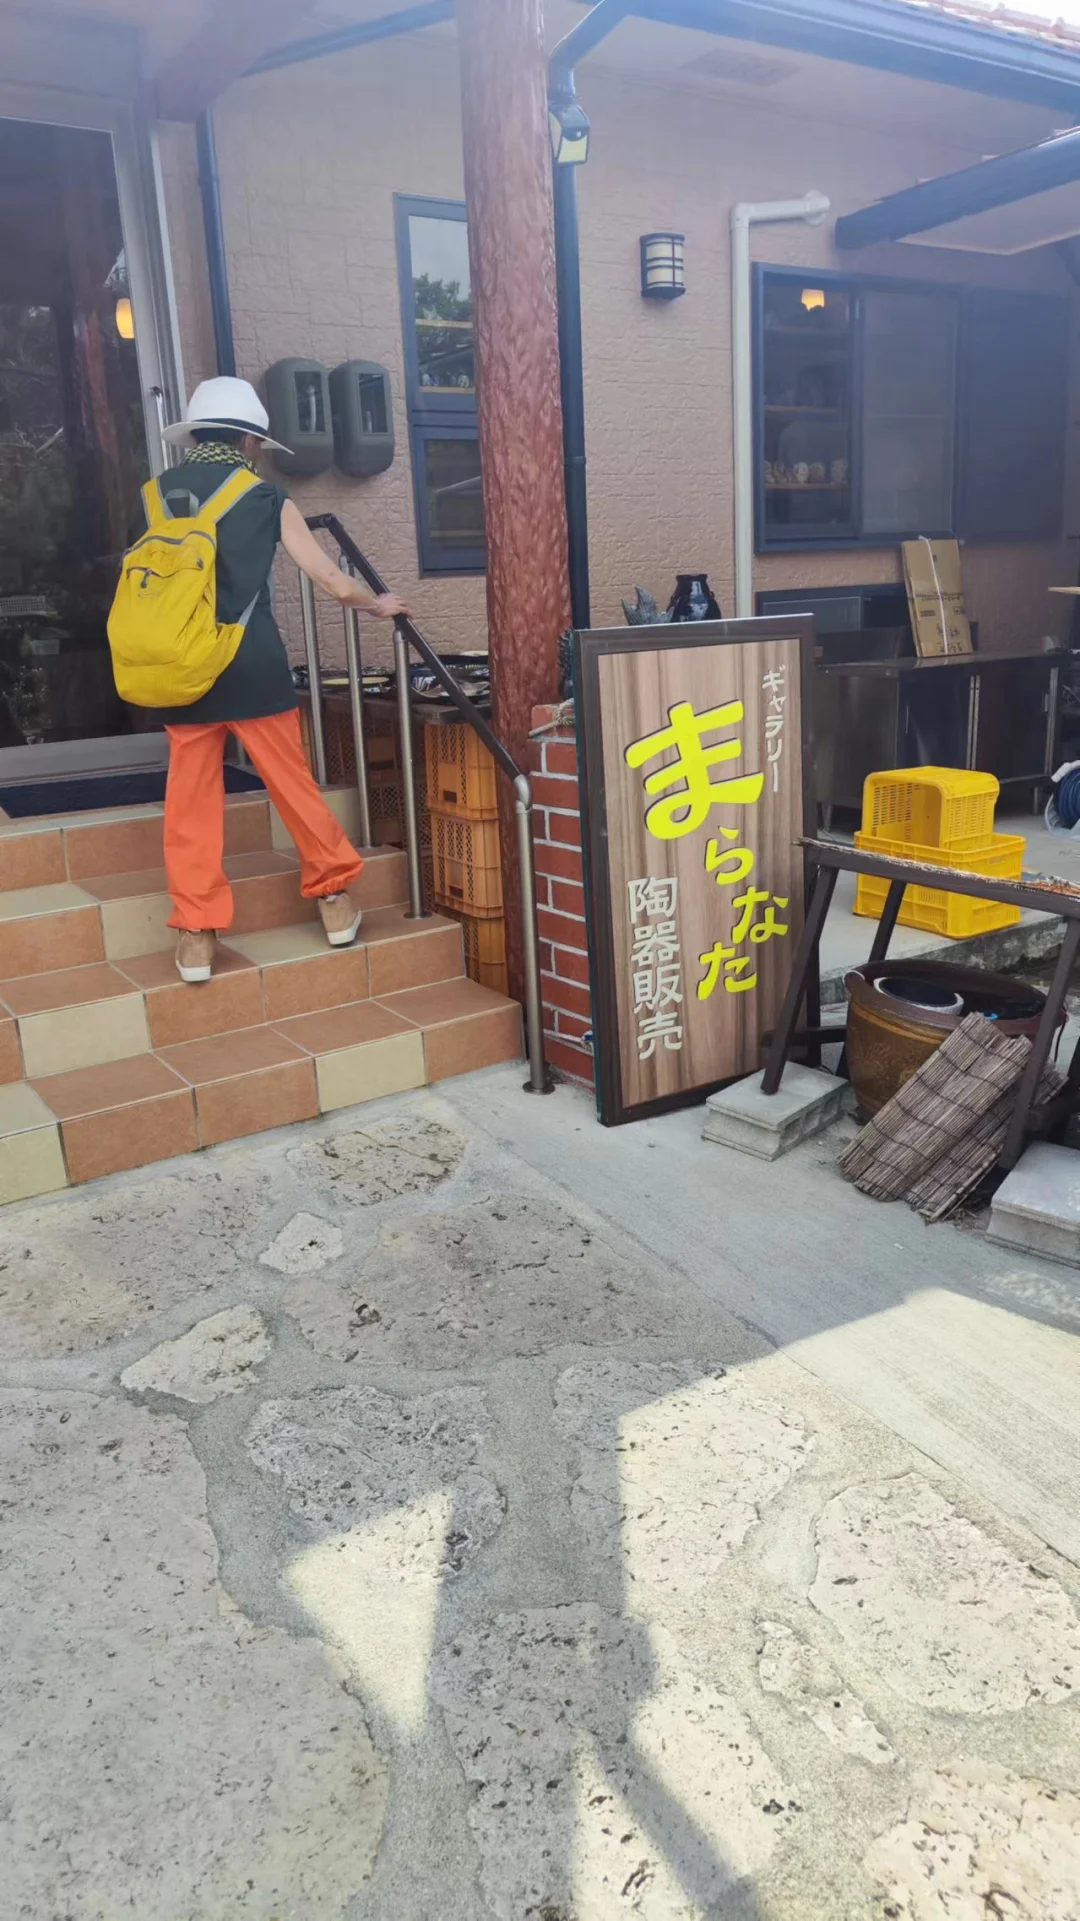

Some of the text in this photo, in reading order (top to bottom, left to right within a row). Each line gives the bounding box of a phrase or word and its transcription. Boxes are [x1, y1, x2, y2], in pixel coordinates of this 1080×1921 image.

[762, 665, 787, 792] ギャラリー
[627, 876, 684, 1060] 陶器販売
